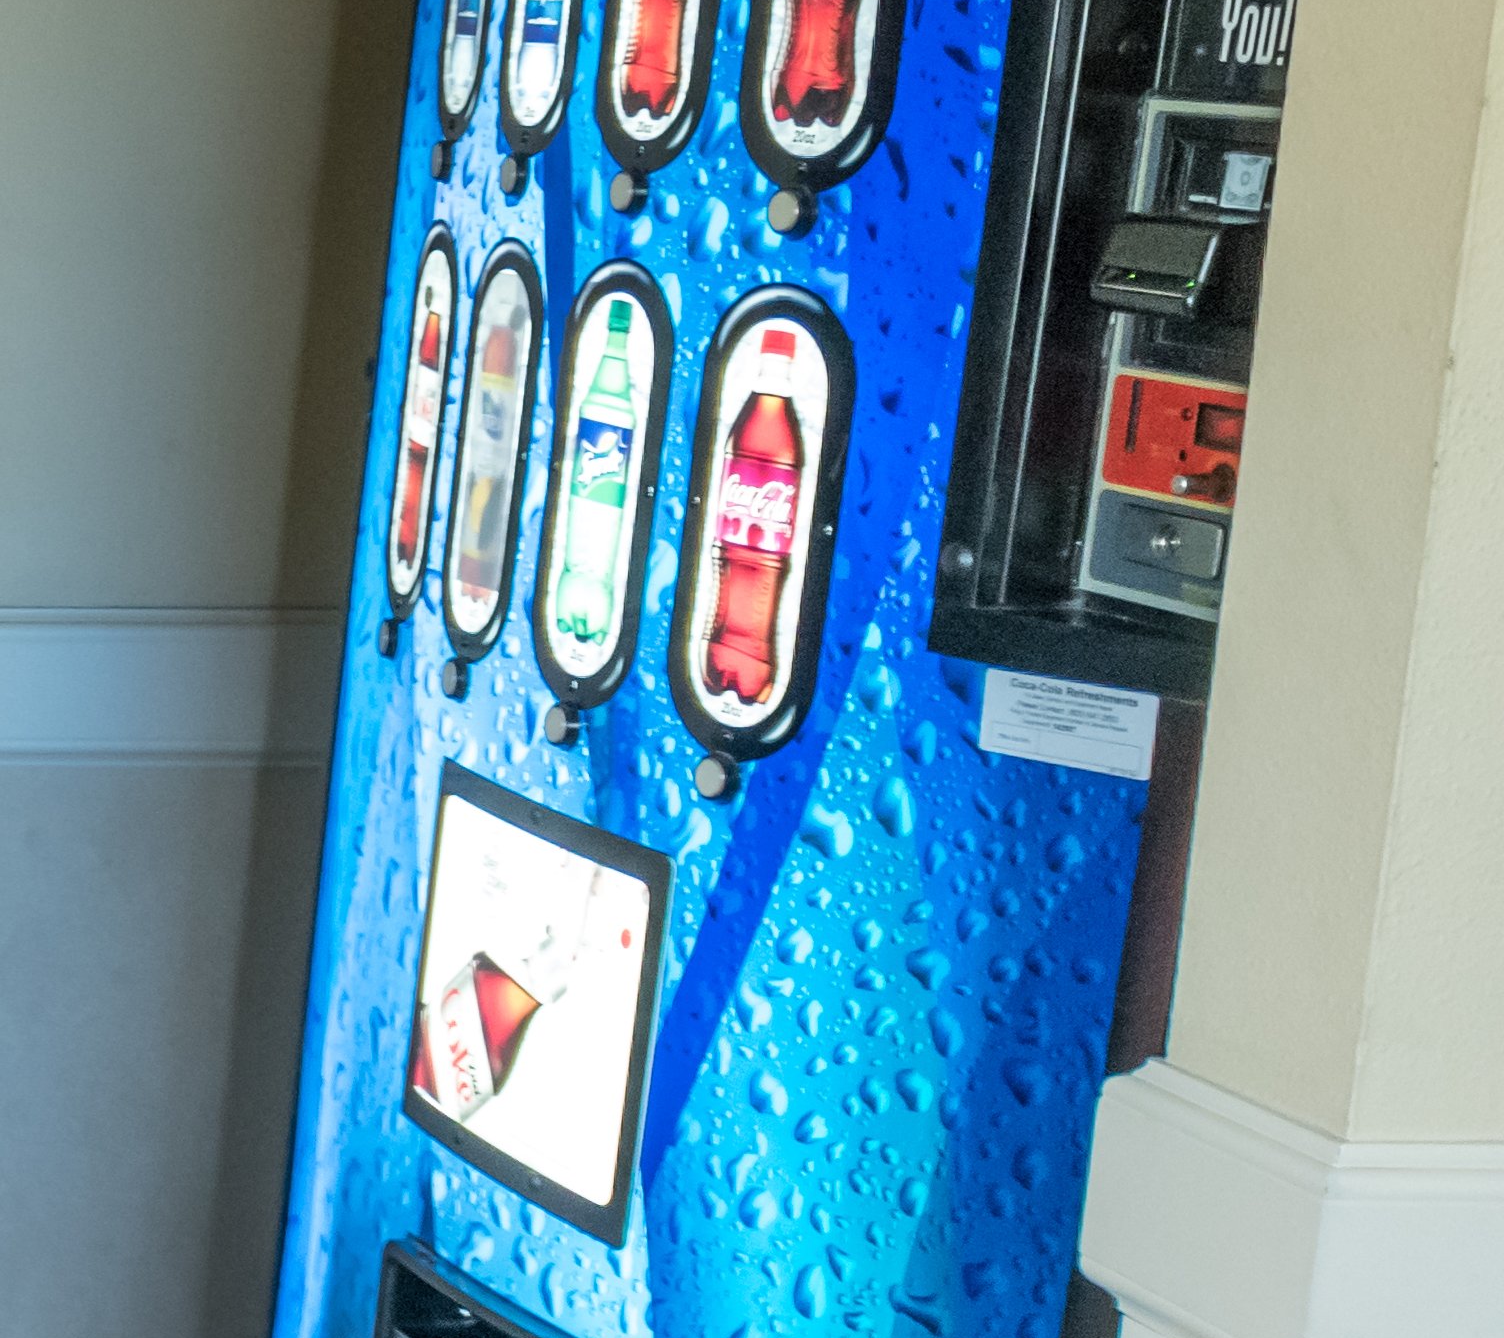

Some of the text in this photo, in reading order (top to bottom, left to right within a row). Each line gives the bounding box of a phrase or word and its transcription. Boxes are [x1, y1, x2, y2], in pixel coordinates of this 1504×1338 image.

[726, 472, 793, 523] Coca-Cola
[1010, 678, 1139, 708] Coca-Cola Refreshments
